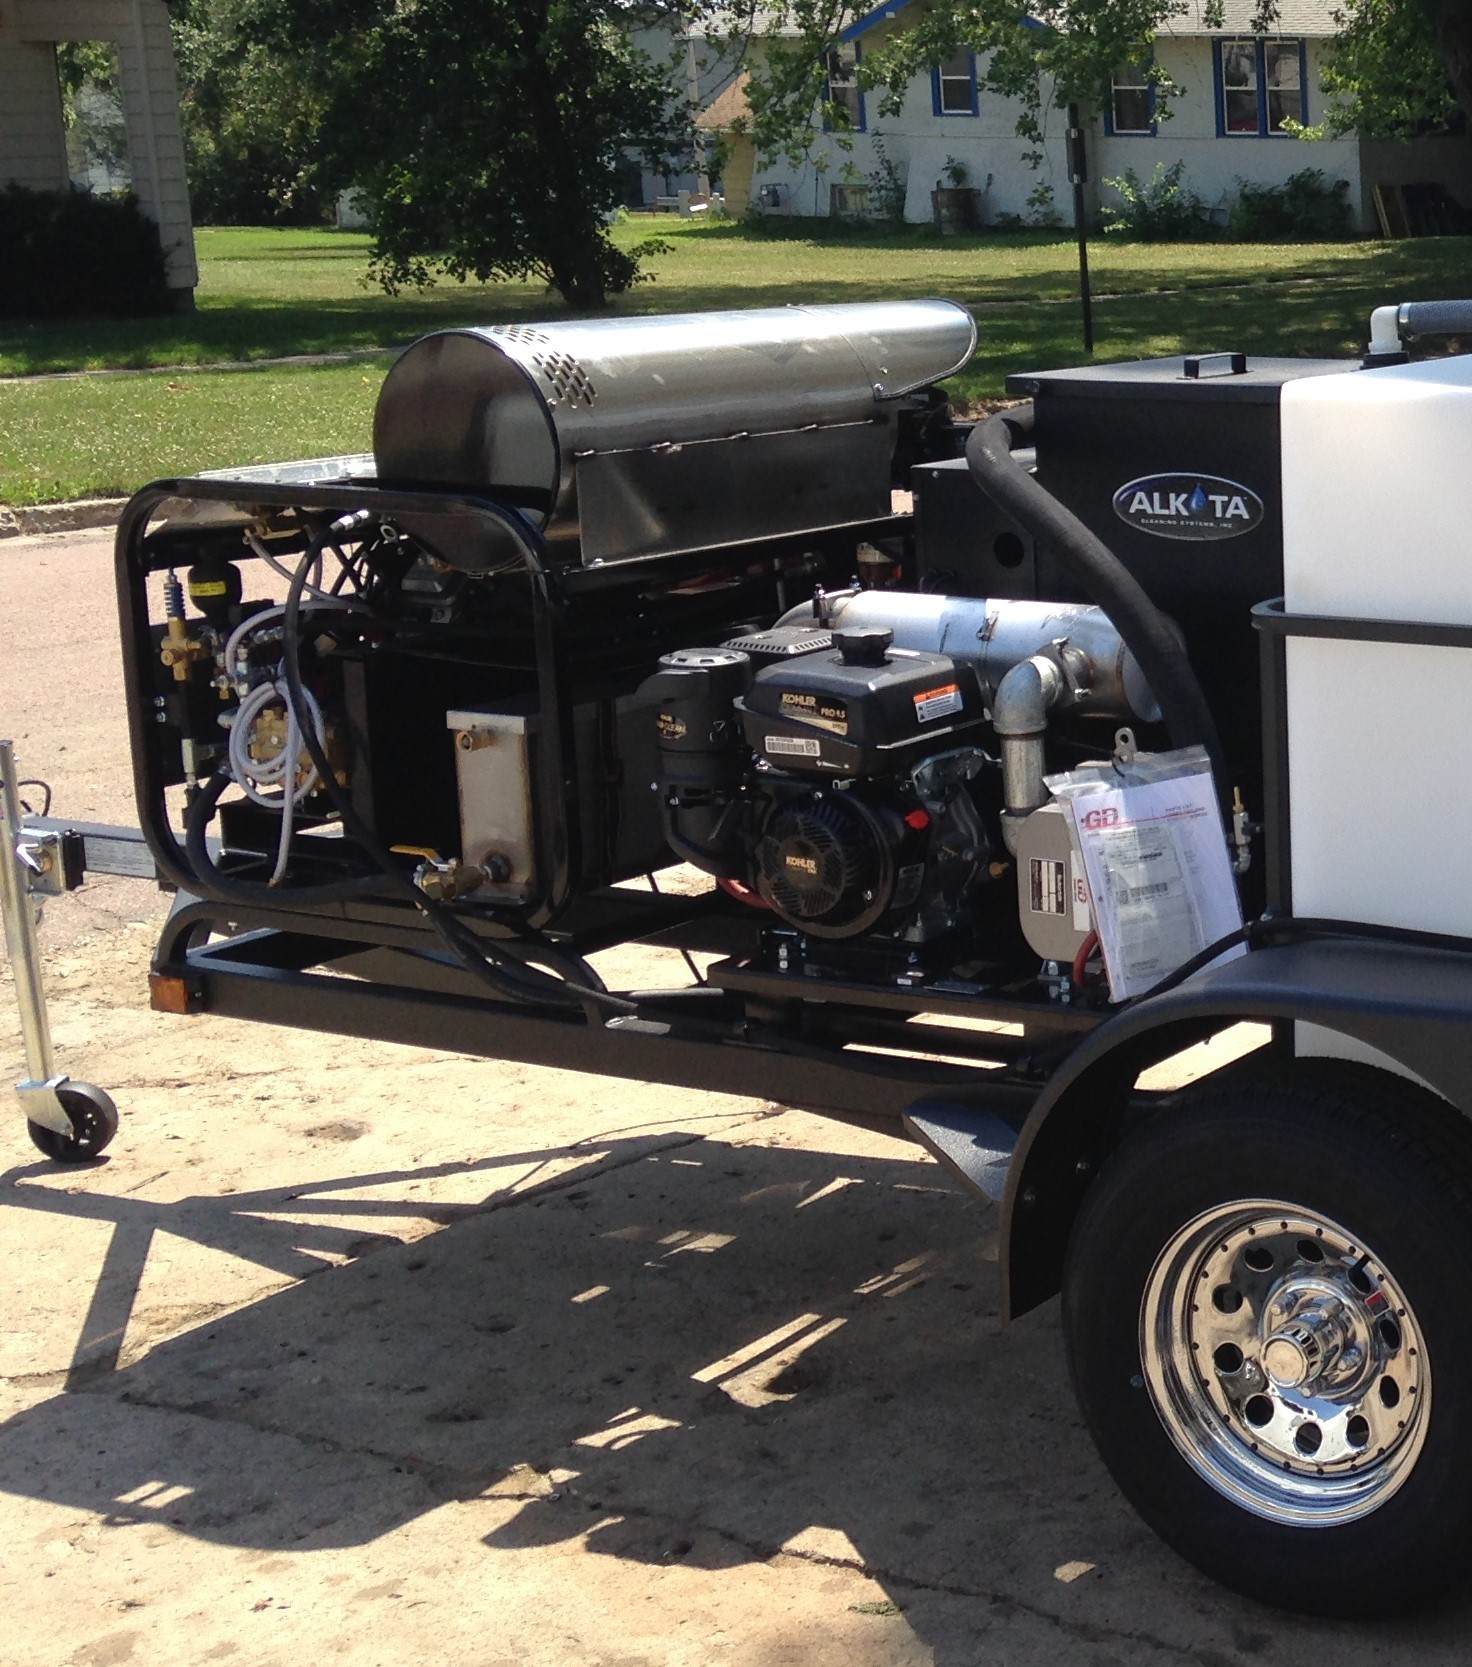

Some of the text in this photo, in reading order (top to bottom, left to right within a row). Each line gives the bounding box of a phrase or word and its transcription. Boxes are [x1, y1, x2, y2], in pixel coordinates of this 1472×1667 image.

[1128, 482, 1250, 519] ALKOTA
[782, 693, 816, 706] KOHLER
[820, 707, 835, 717] PRO
[1084, 808, 1118, 829] GD
[785, 856, 816, 869] KOHLER
